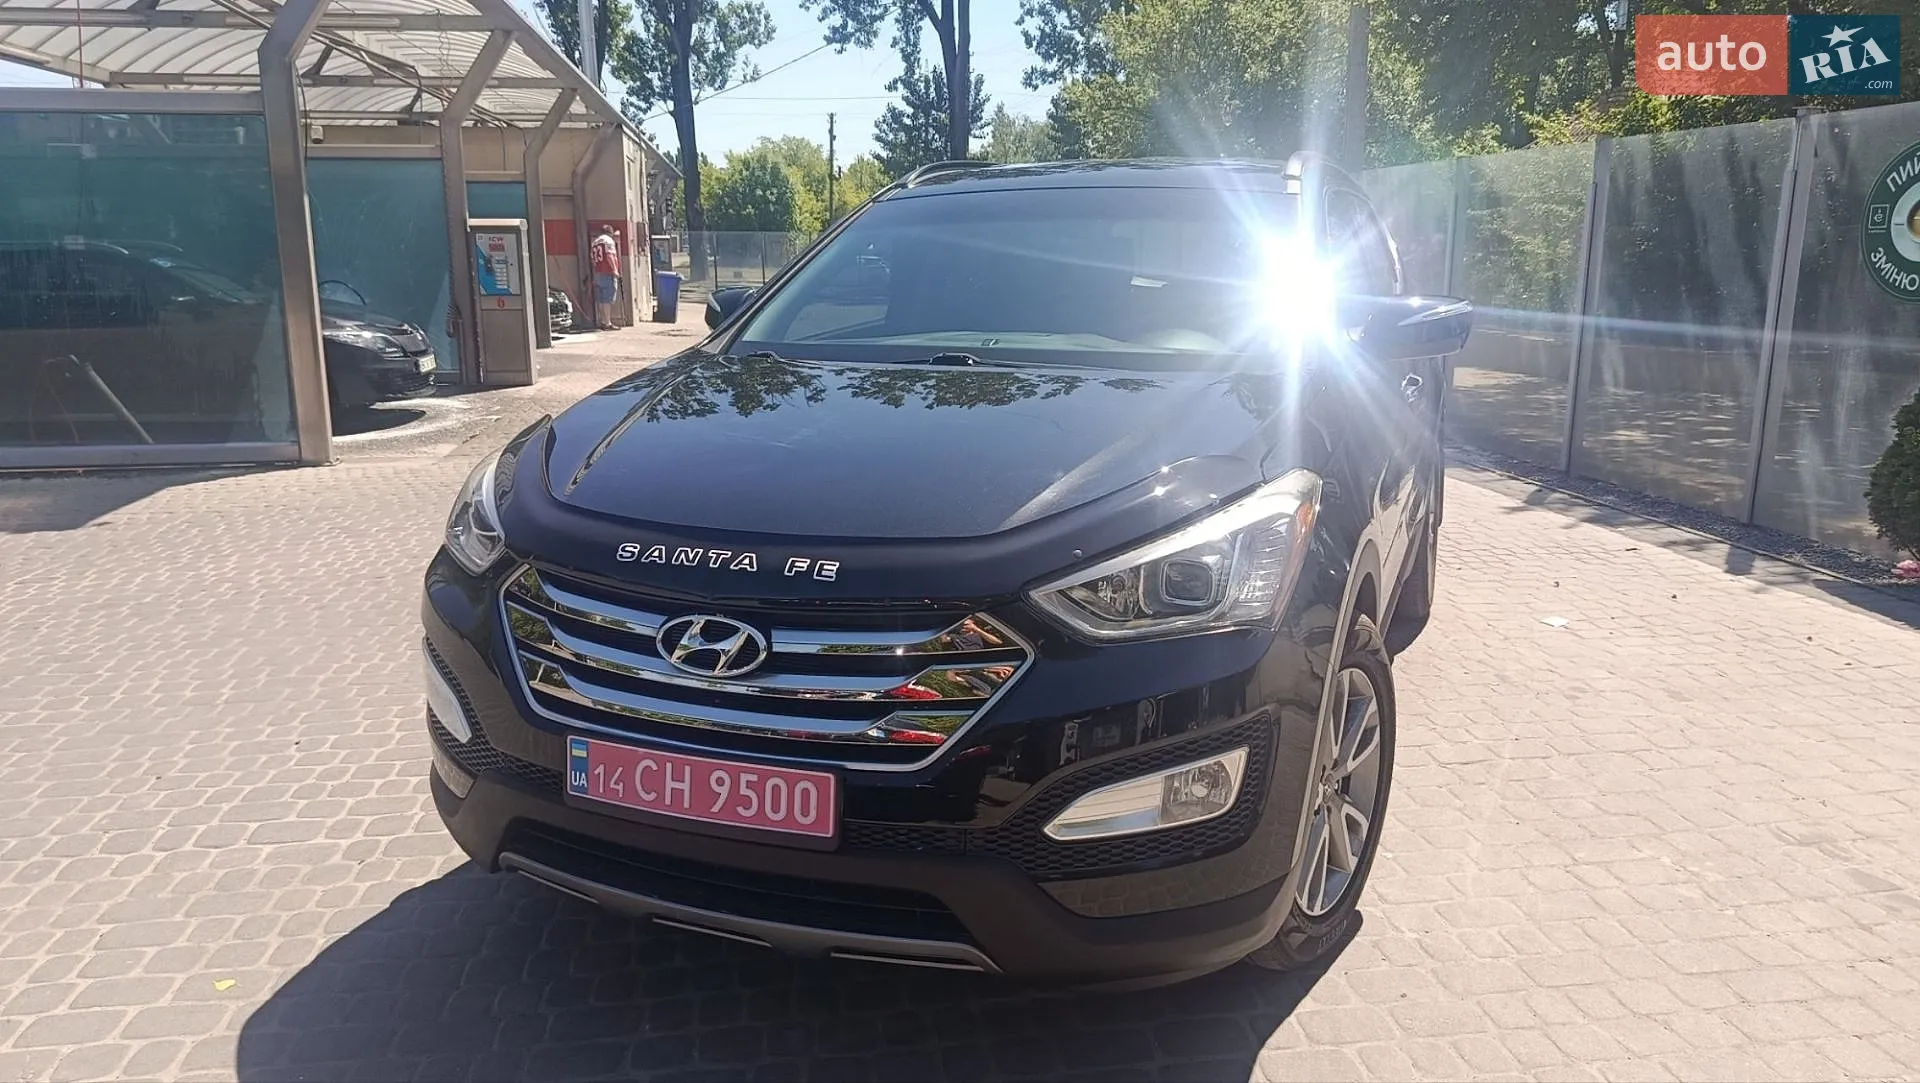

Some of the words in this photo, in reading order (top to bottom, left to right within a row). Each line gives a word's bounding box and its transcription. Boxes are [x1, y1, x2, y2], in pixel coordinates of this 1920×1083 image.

[616, 543, 757, 571] SANTA
[784, 557, 840, 582] FE
[571, 770, 588, 788] UA
[593, 763, 625, 798] 14
[709, 769, 818, 825] 9500
